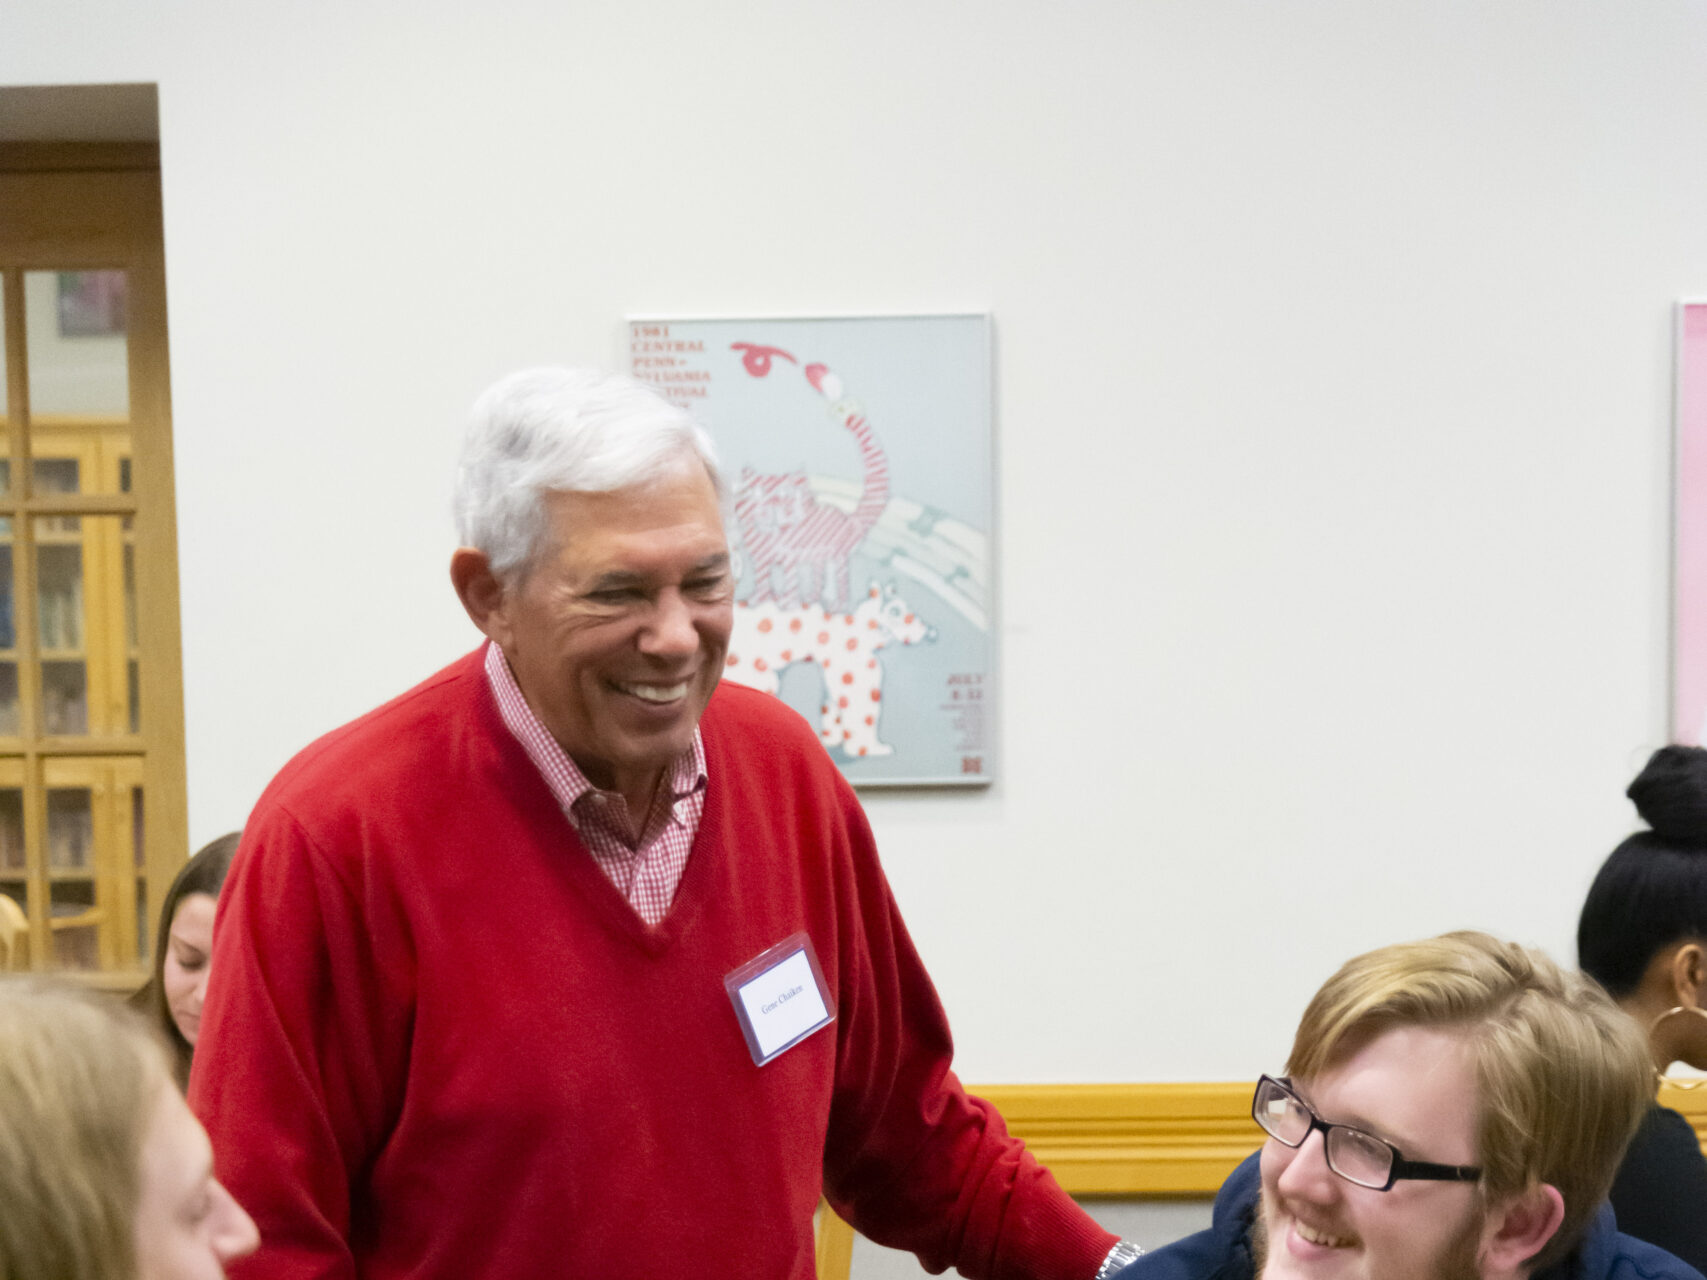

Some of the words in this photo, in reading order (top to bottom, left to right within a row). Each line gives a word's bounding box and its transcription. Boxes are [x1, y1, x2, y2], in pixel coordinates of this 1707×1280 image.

[631, 340, 705, 352] CENTRAL
[664, 385, 708, 398] TIVAL
[761, 1001, 778, 1015] Gene
